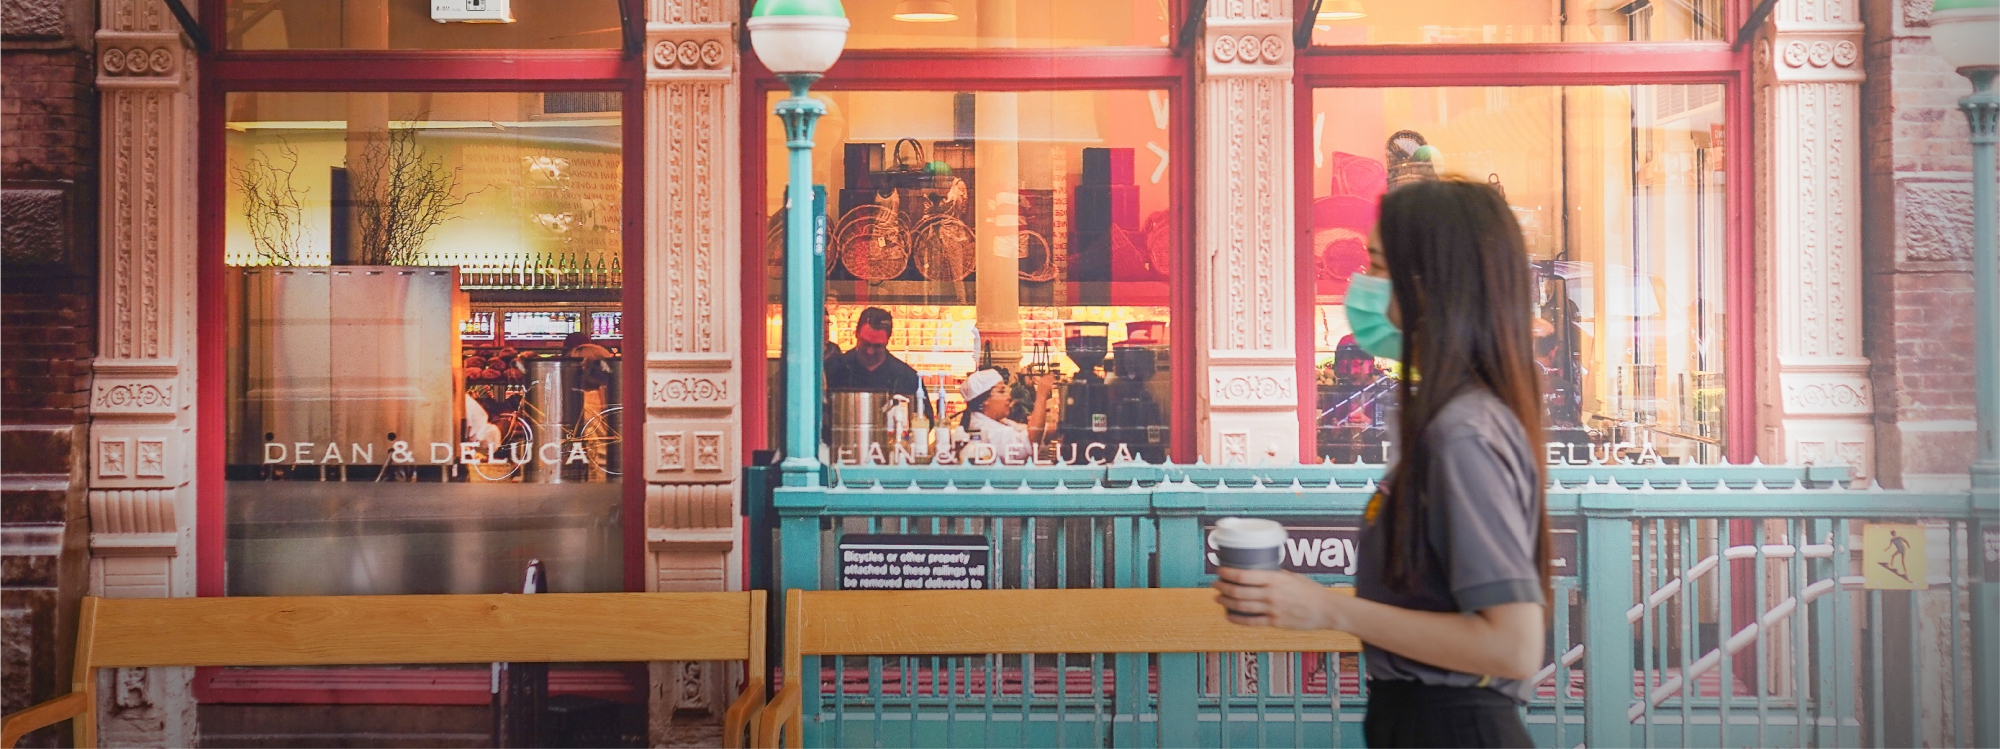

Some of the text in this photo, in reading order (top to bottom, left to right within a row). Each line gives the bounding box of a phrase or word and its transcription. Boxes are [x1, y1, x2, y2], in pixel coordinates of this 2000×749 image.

[264, 440, 589, 465] DEAN & DELUCA
[837, 441, 916, 464] EAN
[974, 441, 1134, 465] DELUCA
[1545, 441, 1657, 464] ELUCA
[843, 550, 971, 565] Bicycles or other property
[843, 563, 986, 577] attached to these railings will
[843, 576, 983, 589] be removed and delivered to
